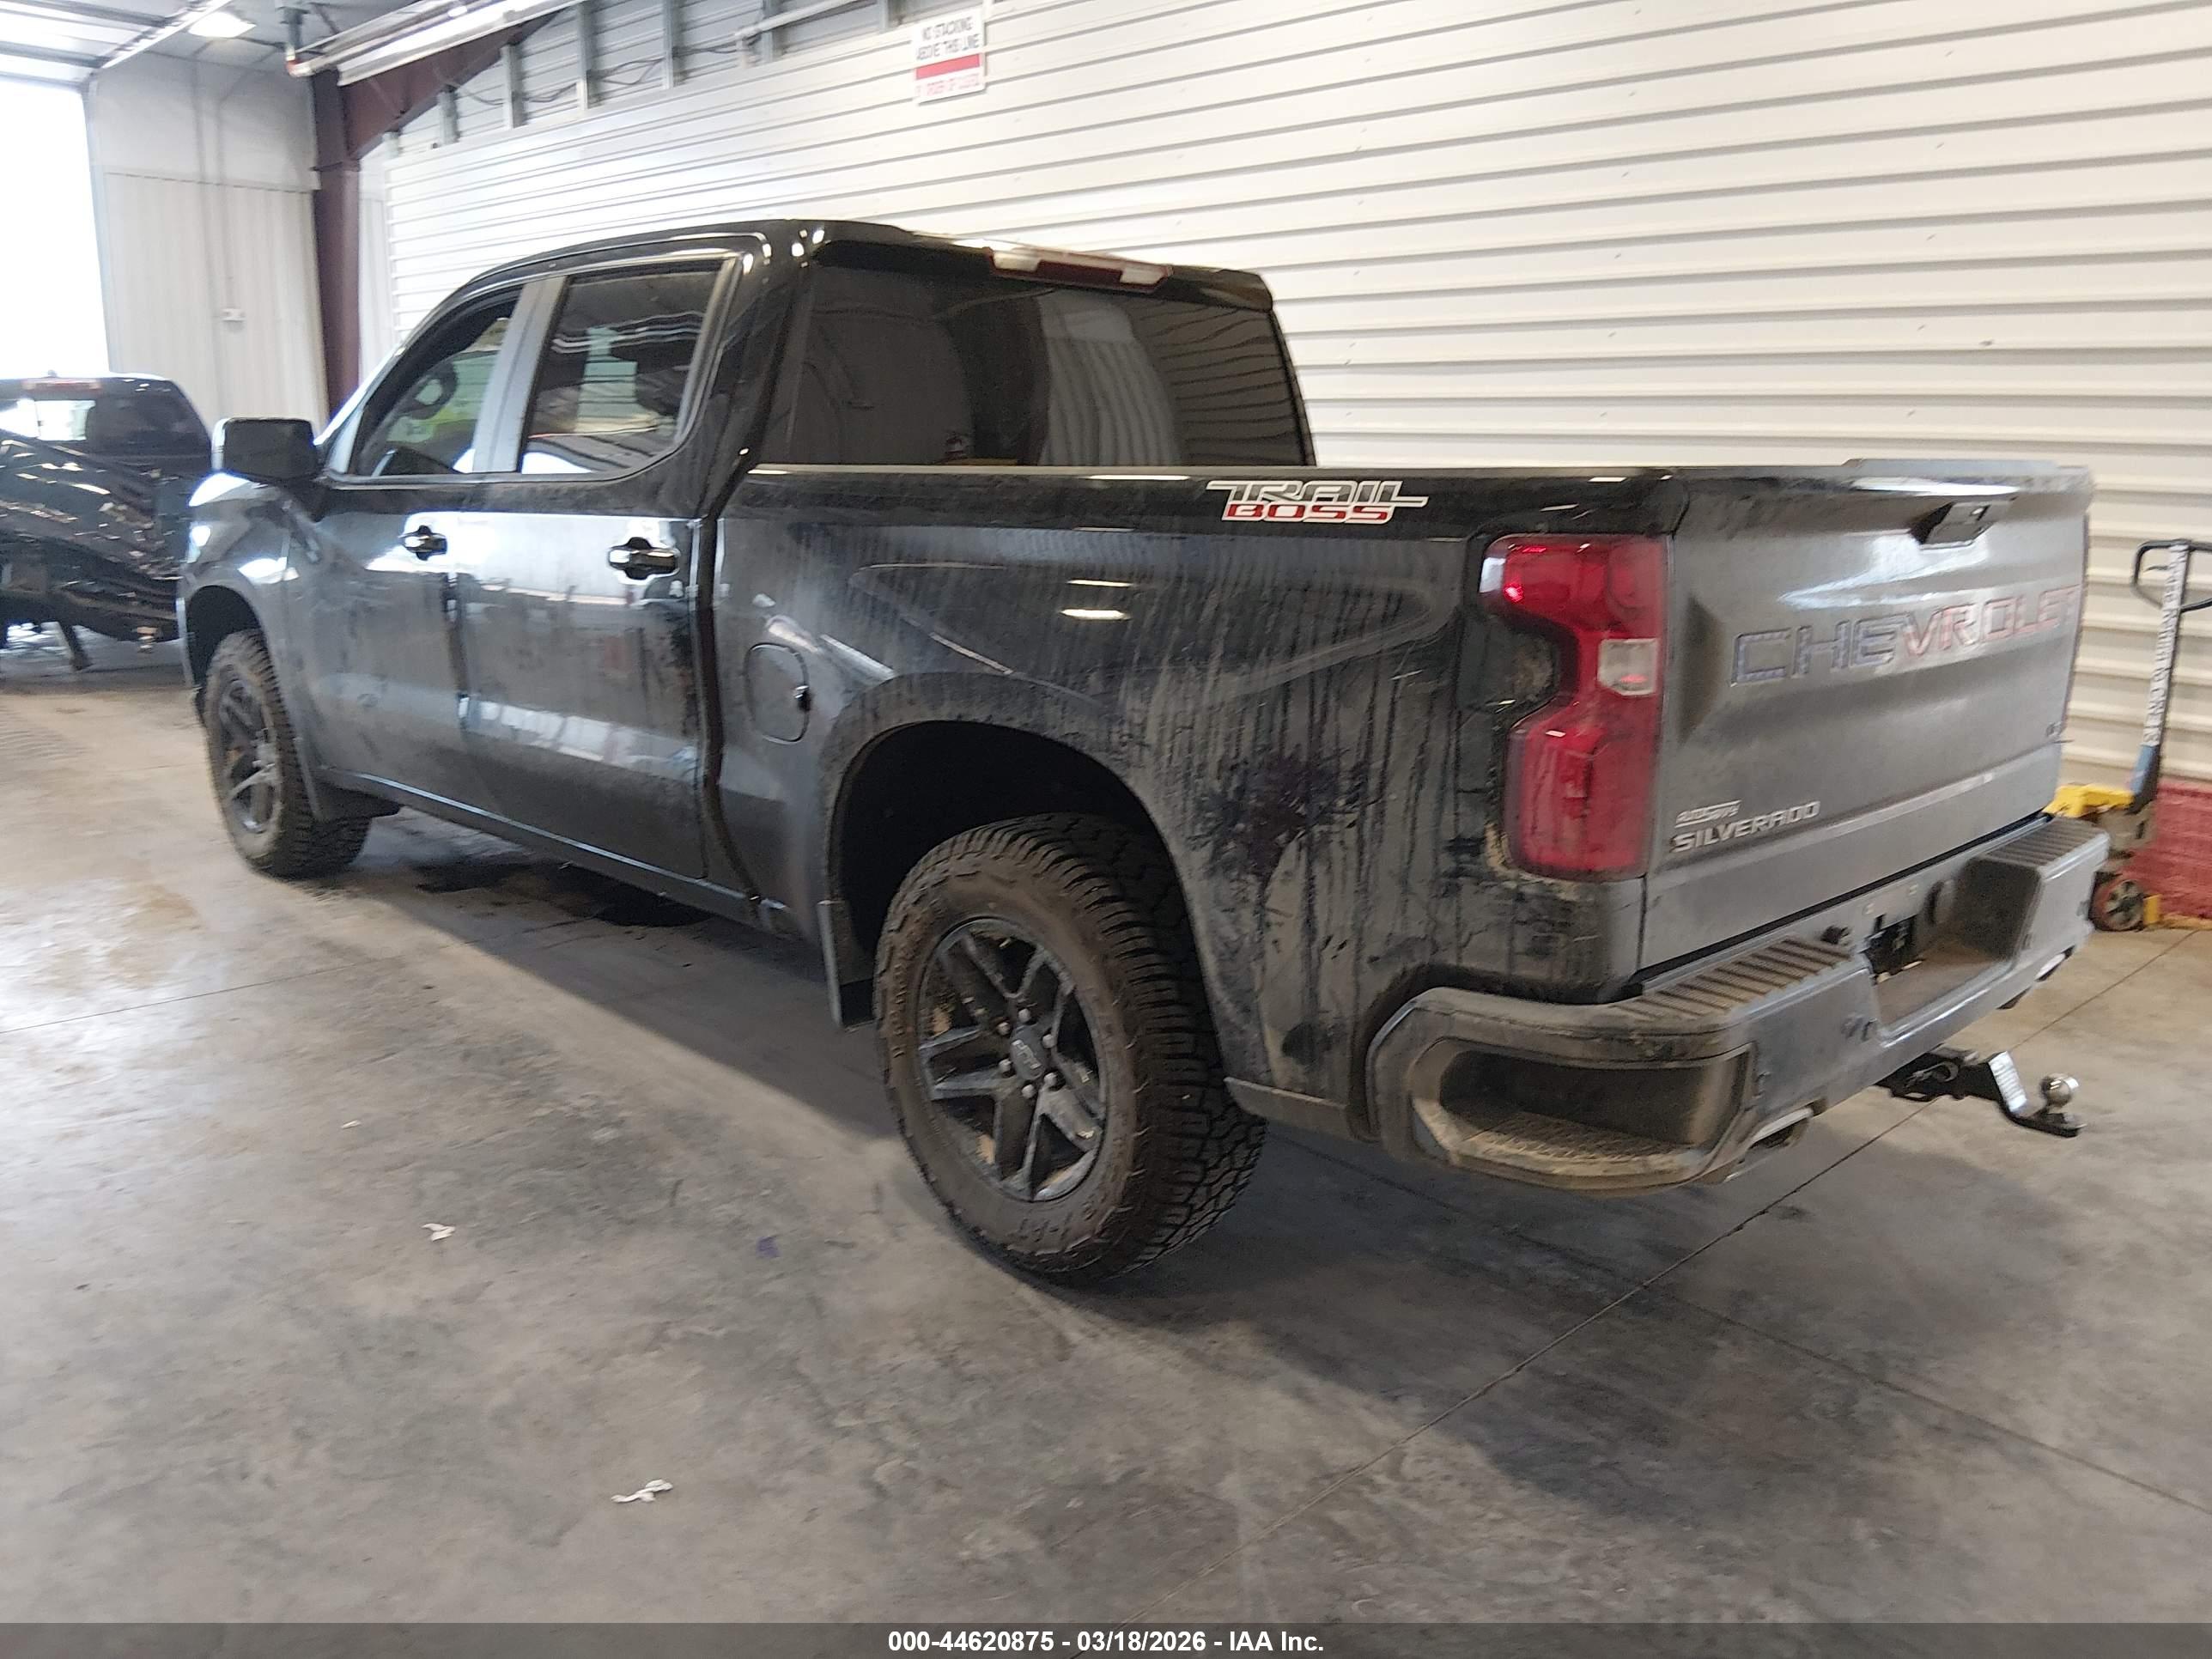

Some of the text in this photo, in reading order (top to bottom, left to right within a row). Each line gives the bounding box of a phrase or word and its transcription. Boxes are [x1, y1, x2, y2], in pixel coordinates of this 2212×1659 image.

[1206, 480, 1430, 507] TRAIL
[1221, 502, 1395, 525] BOSS
[1729, 584, 2080, 687] CHEVROLET
[1670, 800, 1820, 853] SILVERADO
